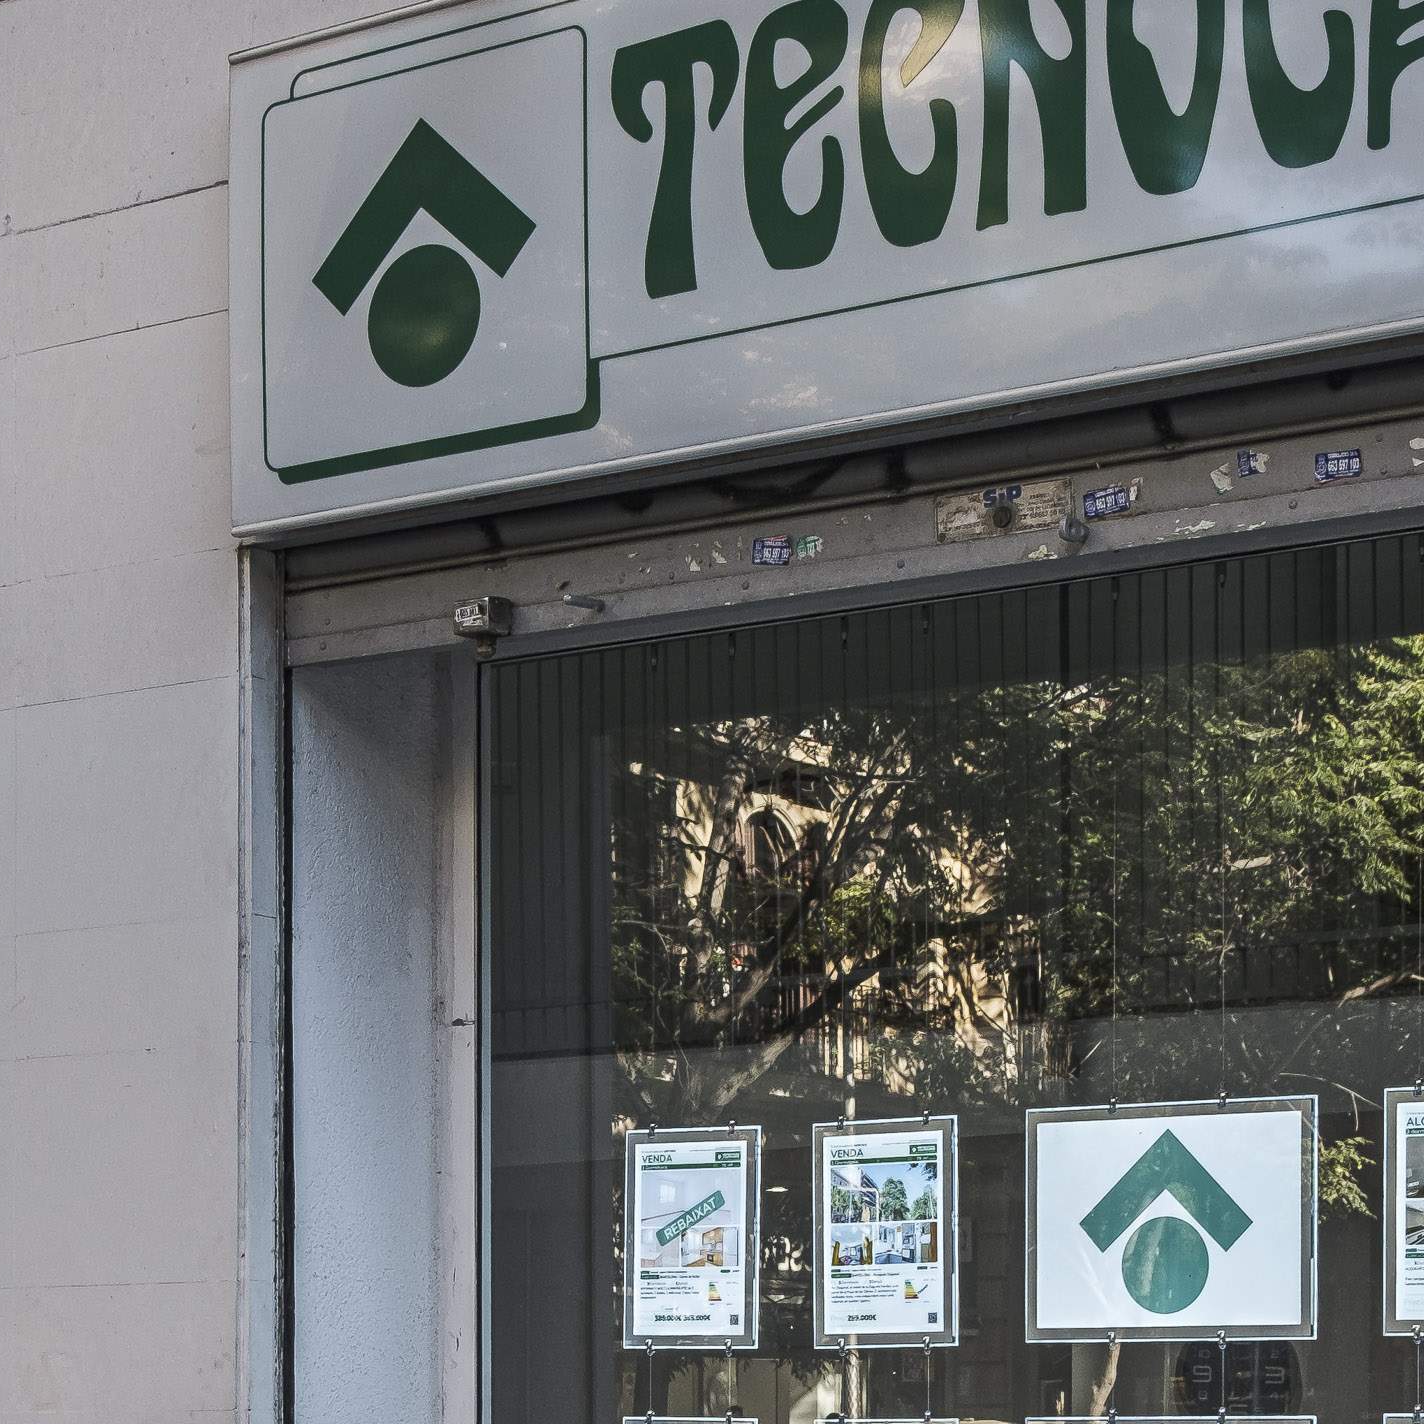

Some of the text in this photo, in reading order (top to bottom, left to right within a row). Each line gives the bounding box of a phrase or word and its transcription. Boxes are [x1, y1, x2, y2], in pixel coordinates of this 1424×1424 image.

[831, 1149, 864, 1158] VENDA
[642, 1155, 672, 1163] VENDA
[663, 1198, 717, 1241] REBAIXAT
